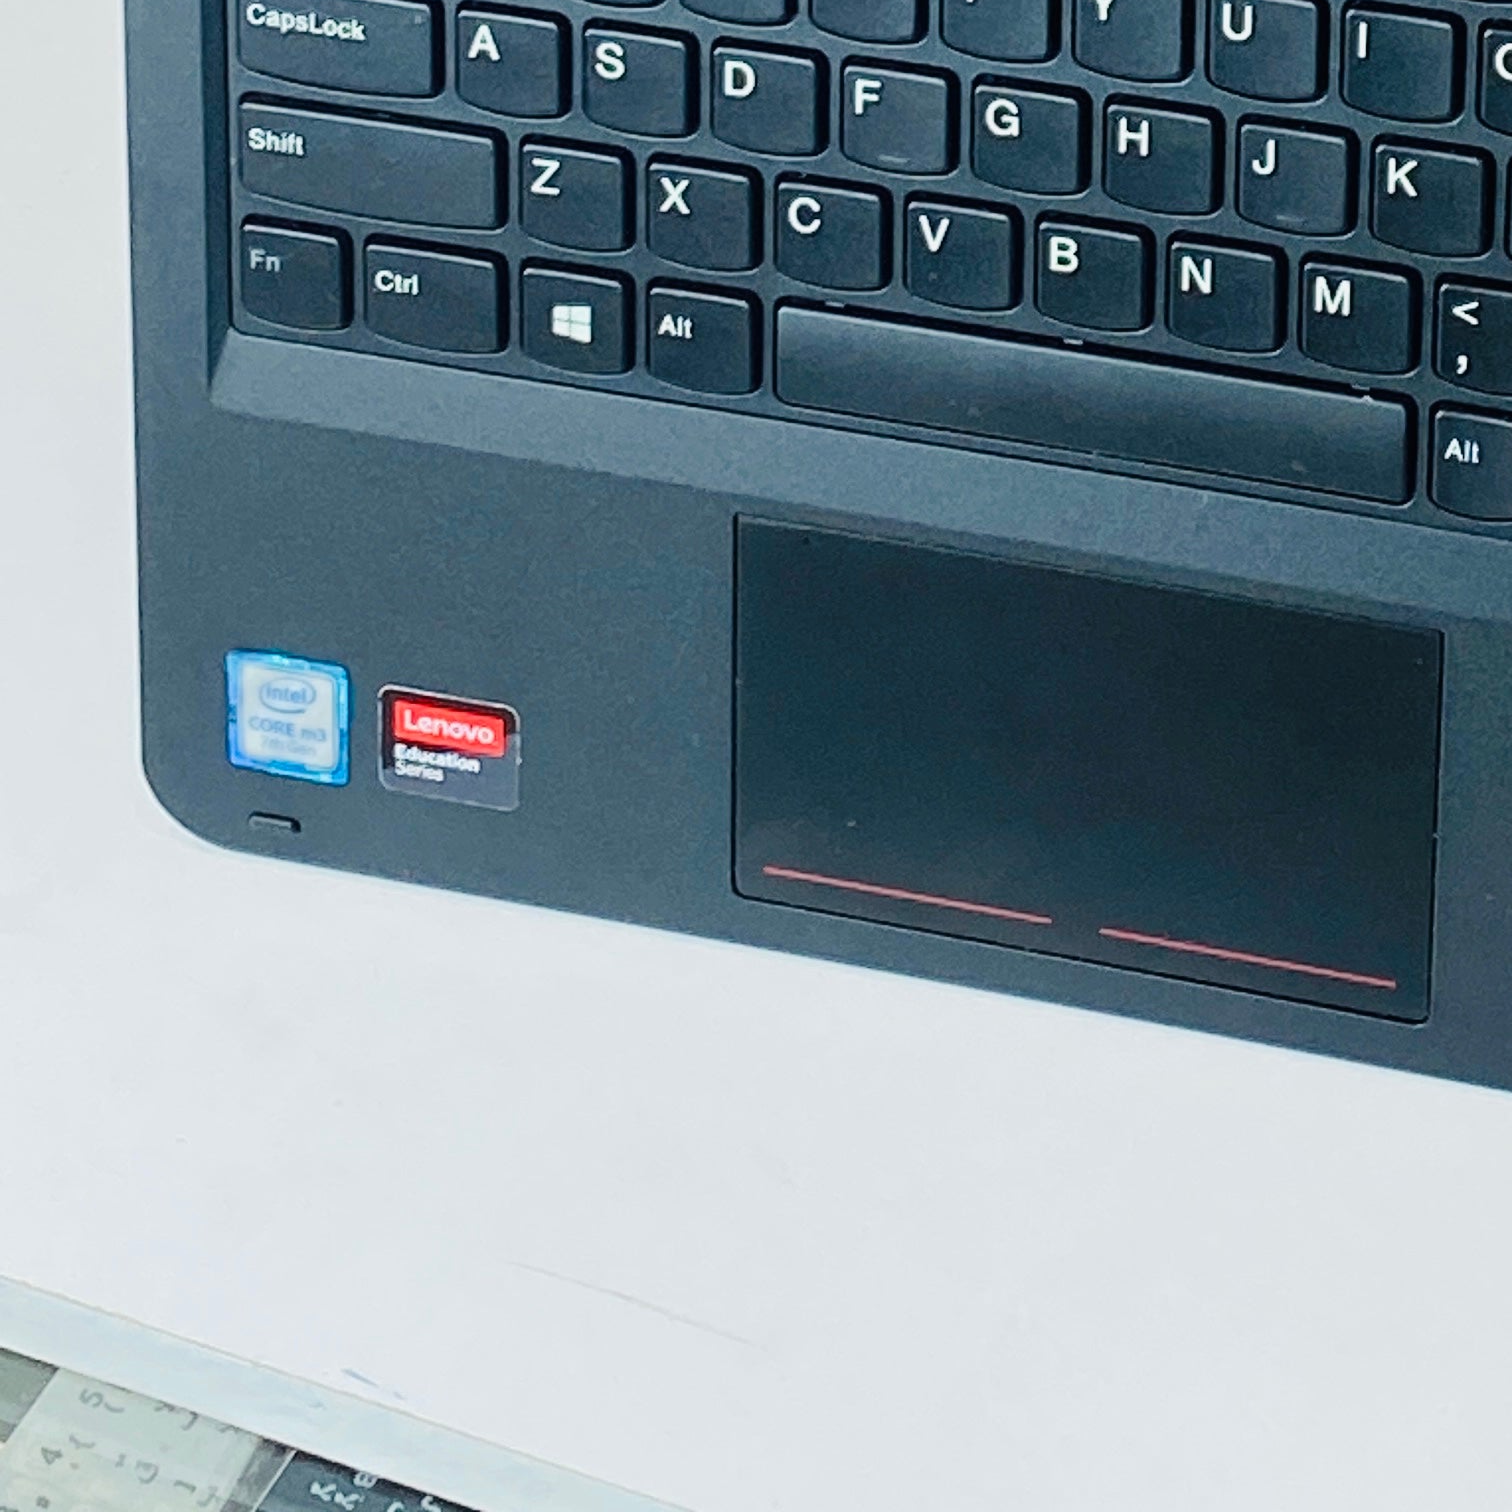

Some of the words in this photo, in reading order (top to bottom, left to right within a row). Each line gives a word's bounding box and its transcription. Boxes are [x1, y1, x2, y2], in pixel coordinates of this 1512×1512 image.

[246, 3, 366, 41] CapsLock
[1222, 2, 1253, 41] U
[1357, 21, 1368, 59] I
[467, 24, 501, 61] A
[594, 41, 625, 80] S
[724, 60, 756, 97] D
[854, 78, 882, 115] F
[985, 98, 1020, 137] G
[1118, 116, 1149, 157] H
[248, 127, 304, 156] Shift
[1252, 138, 1276, 175] J
[530, 157, 560, 196] Z
[1387, 157, 1418, 197] K
[659, 177, 691, 215] X
[787, 196, 821, 234] C
[918, 214, 950, 252] V
[250, 248, 280, 272] Fn
[1048, 235, 1079, 273] B
[374, 269, 419, 296] Ctrl
[1181, 255, 1212, 294] N
[1314, 275, 1351, 317] M
[1452, 301, 1479, 325] <
[657, 313, 693, 339] Alt
[1444, 438, 1480, 464] Alt
[403, 708, 496, 745] Lenovo
[393, 743, 482, 774] Education
[394, 760, 445, 782] Series
